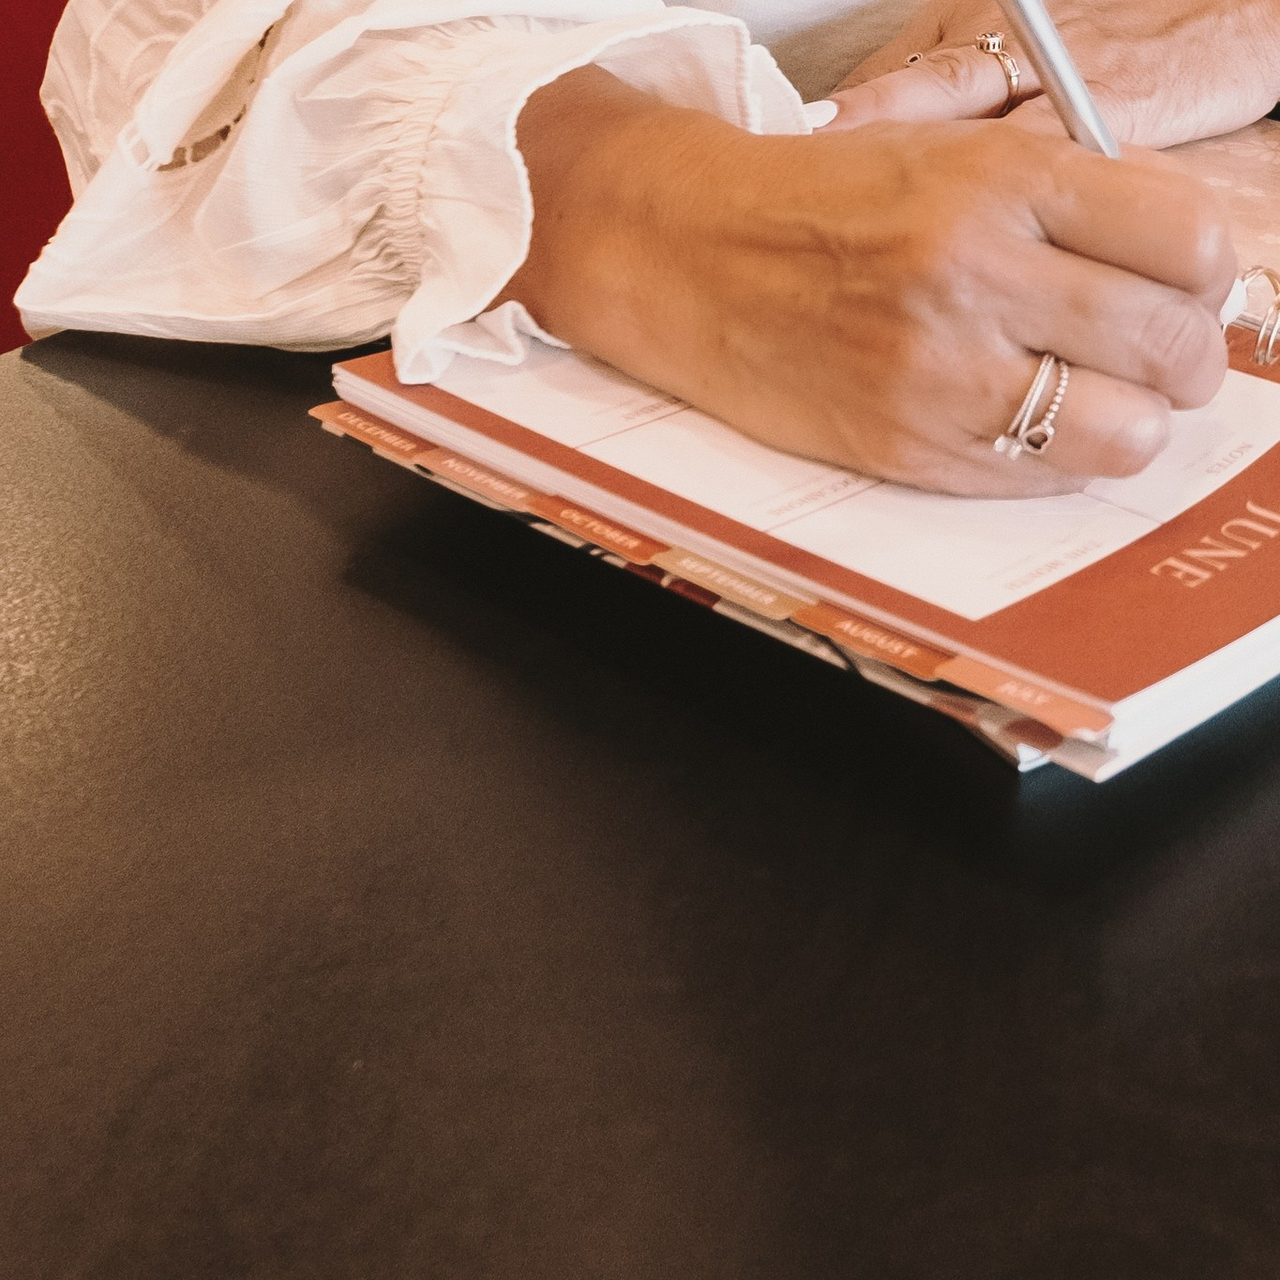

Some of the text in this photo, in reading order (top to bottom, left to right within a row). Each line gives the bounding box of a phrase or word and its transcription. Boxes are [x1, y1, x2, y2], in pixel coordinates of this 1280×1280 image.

[337, 410, 418, 452] DECEMBER
[440, 457, 527, 500] NOVEMBER
[1205, 442, 1253, 475] NOTES
[559, 507, 640, 550] OCTOBER
[834, 620, 919, 659] AUGUST
